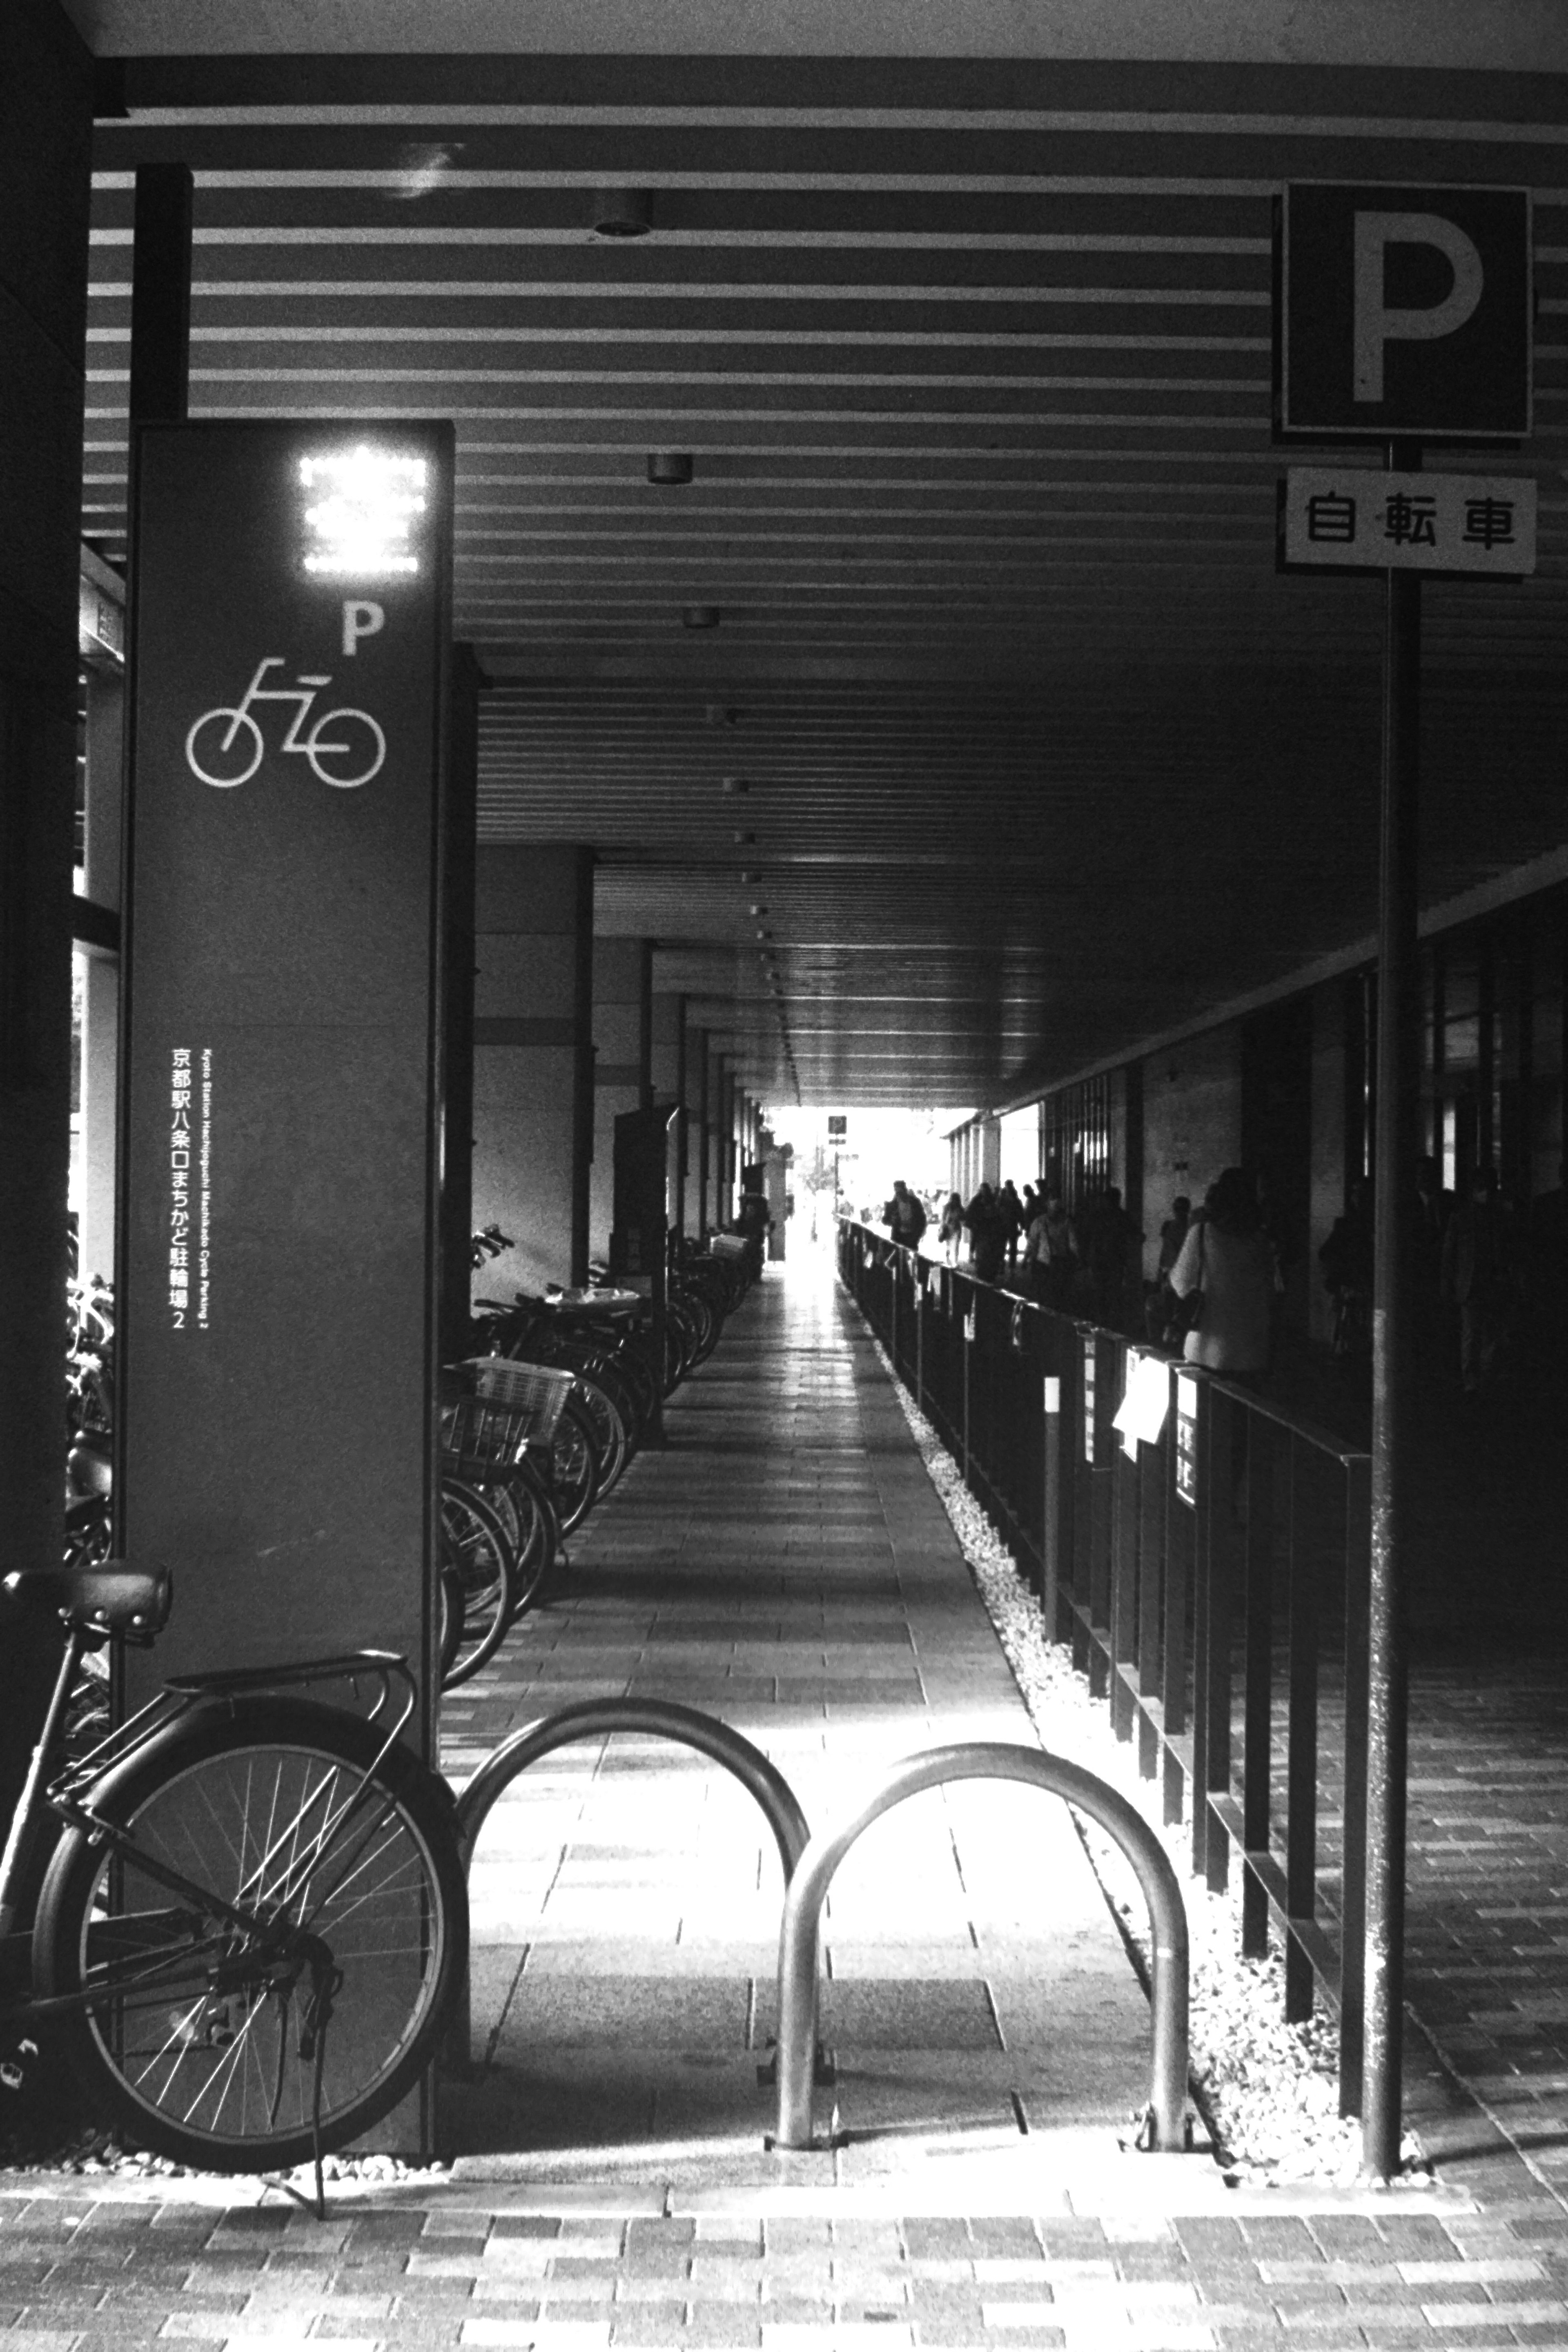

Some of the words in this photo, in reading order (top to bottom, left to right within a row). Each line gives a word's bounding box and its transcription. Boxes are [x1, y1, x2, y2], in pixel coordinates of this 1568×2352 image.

[1353, 211, 1483, 402] P
[1308, 491, 1515, 550] 自転車
[343, 600, 385, 655] P
[201, 1049, 212, 1079] Kyoto
[202, 1081, 212, 1118] Station
[200, 1191, 211, 1247] Machikado
[199, 1250, 210, 1277] Cycle
[197, 1281, 209, 1319] Parking
